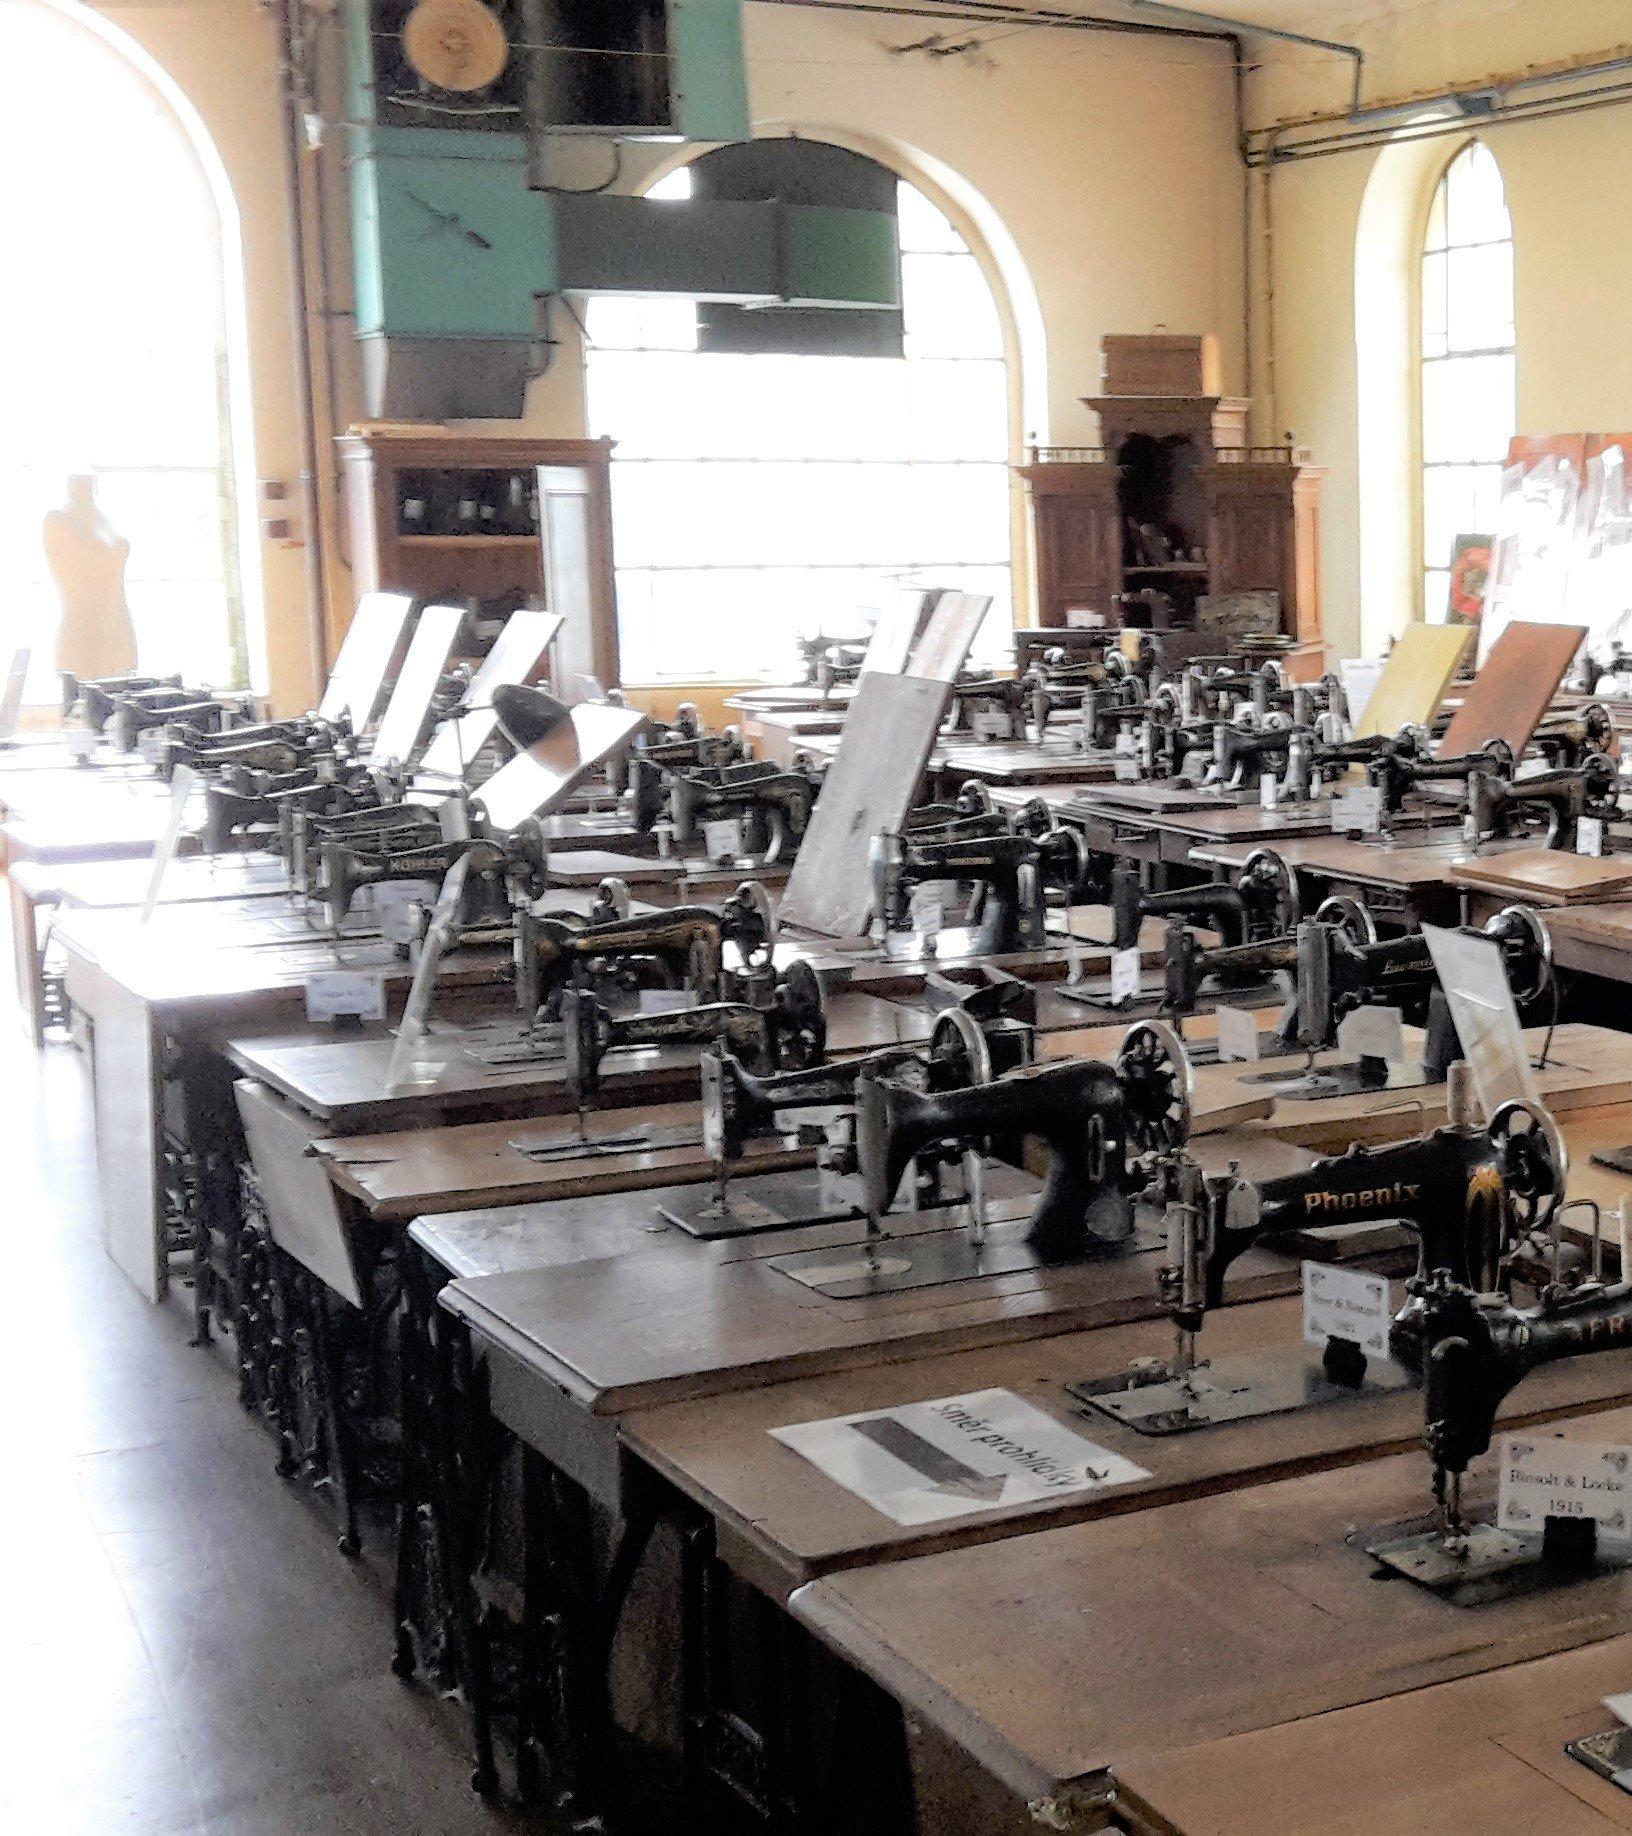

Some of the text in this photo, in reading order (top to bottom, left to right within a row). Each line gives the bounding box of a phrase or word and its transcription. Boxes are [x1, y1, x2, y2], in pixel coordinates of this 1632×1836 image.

[1303, 1182, 1421, 1215] Phoenix
[1563, 1475, 1576, 1489] &
[1550, 1499, 1583, 1515] 1915
